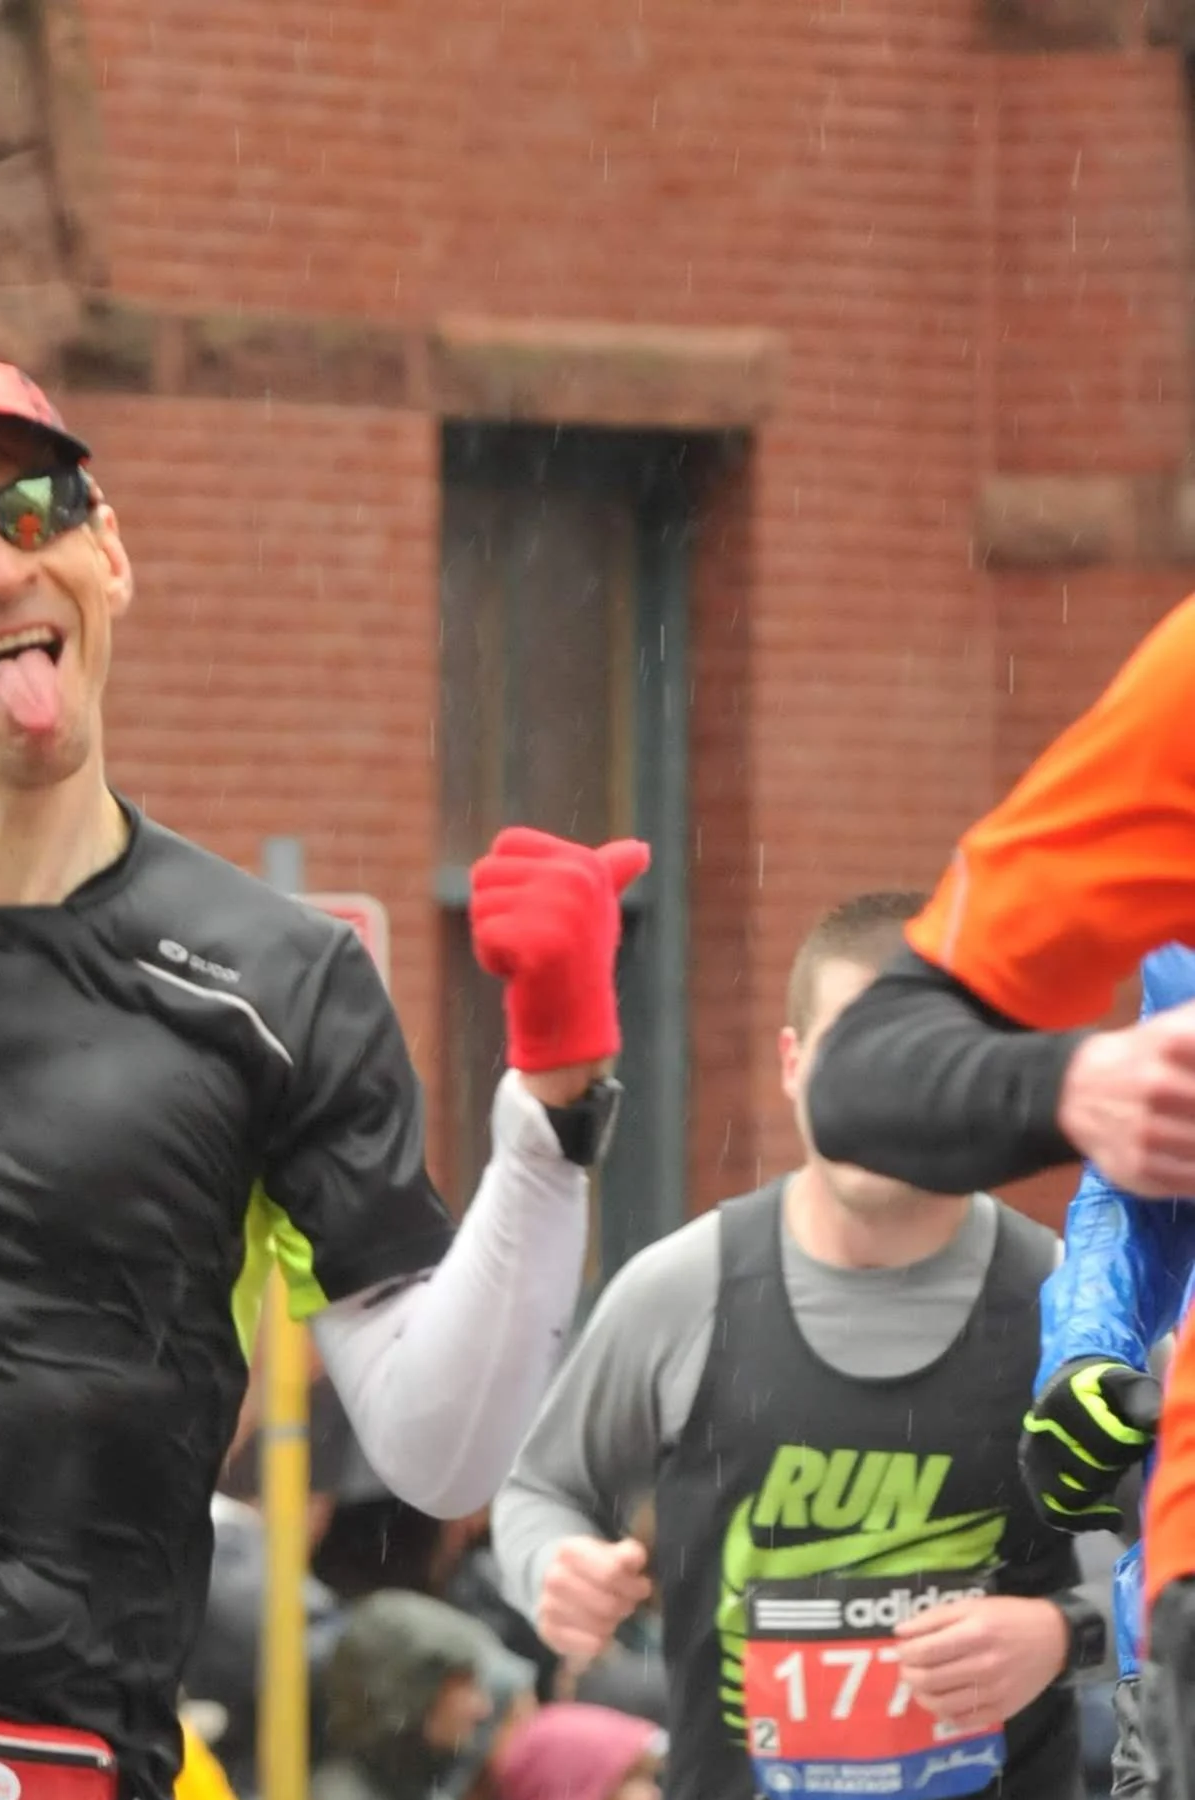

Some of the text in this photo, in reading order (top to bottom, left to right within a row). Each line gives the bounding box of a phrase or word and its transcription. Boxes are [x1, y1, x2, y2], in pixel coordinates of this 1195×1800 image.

[753, 1445, 952, 1533] RUN
[774, 1649, 911, 1721] 177
[755, 1721, 777, 1751] 2
